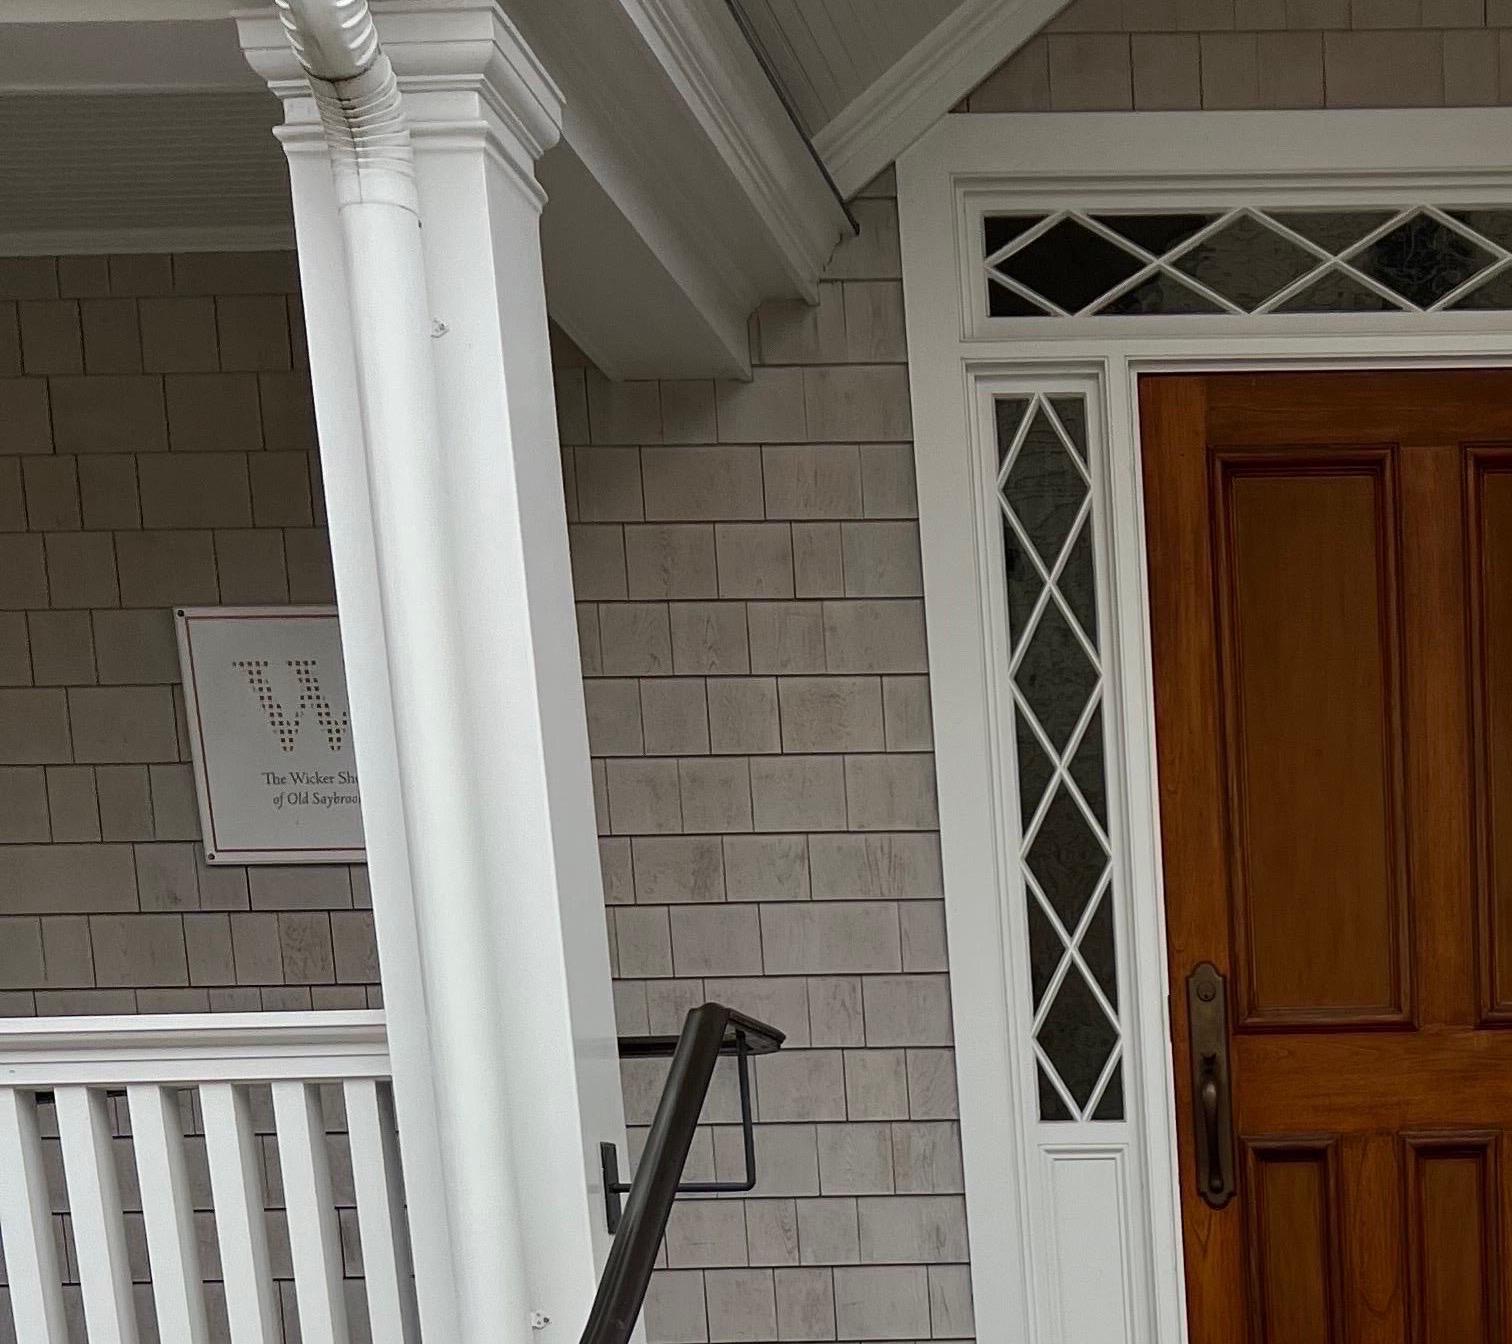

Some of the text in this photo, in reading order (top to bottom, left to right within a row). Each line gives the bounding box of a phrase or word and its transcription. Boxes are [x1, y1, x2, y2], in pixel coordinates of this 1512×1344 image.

[232, 660, 348, 752] W
[261, 770, 287, 785] The
[288, 770, 335, 785] Wicker
[273, 791, 361, 810] of Old Saybroo
